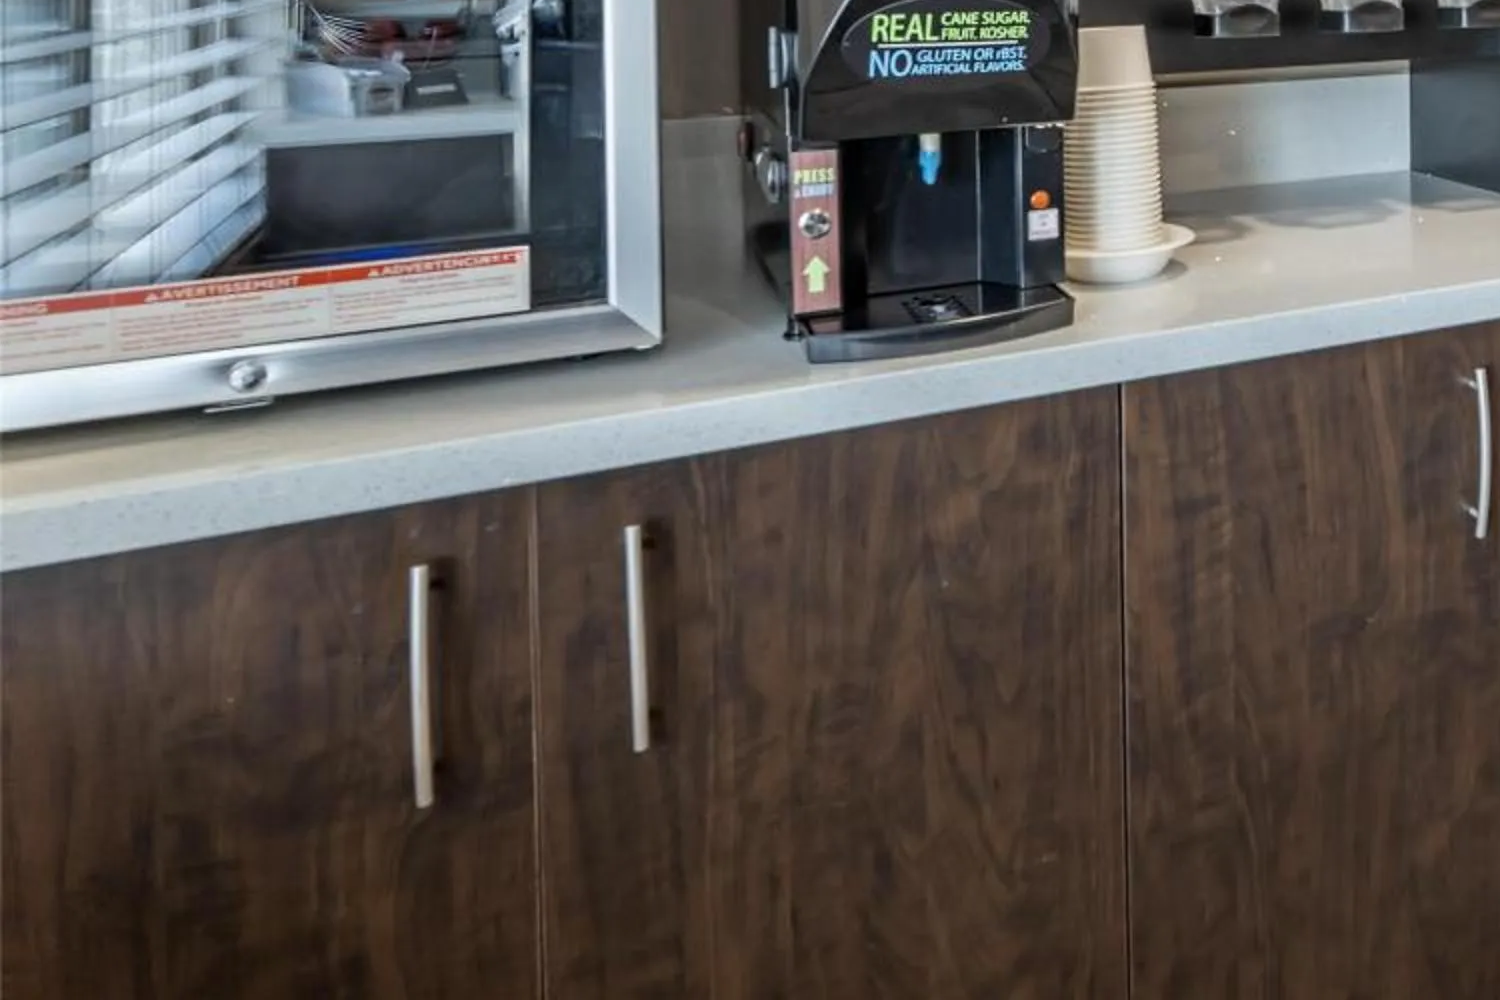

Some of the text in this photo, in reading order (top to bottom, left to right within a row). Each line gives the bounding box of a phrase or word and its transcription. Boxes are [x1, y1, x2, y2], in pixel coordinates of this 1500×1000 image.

[941, 12, 979, 26] CANE
[871, 13, 939, 43] REAL
[917, 48, 971, 63] GLUTEN
[974, 47, 994, 61] OR
[868, 50, 913, 78] NO
[911, 61, 972, 76] ARTIFICIAL
[793, 167, 834, 184] PRESS
